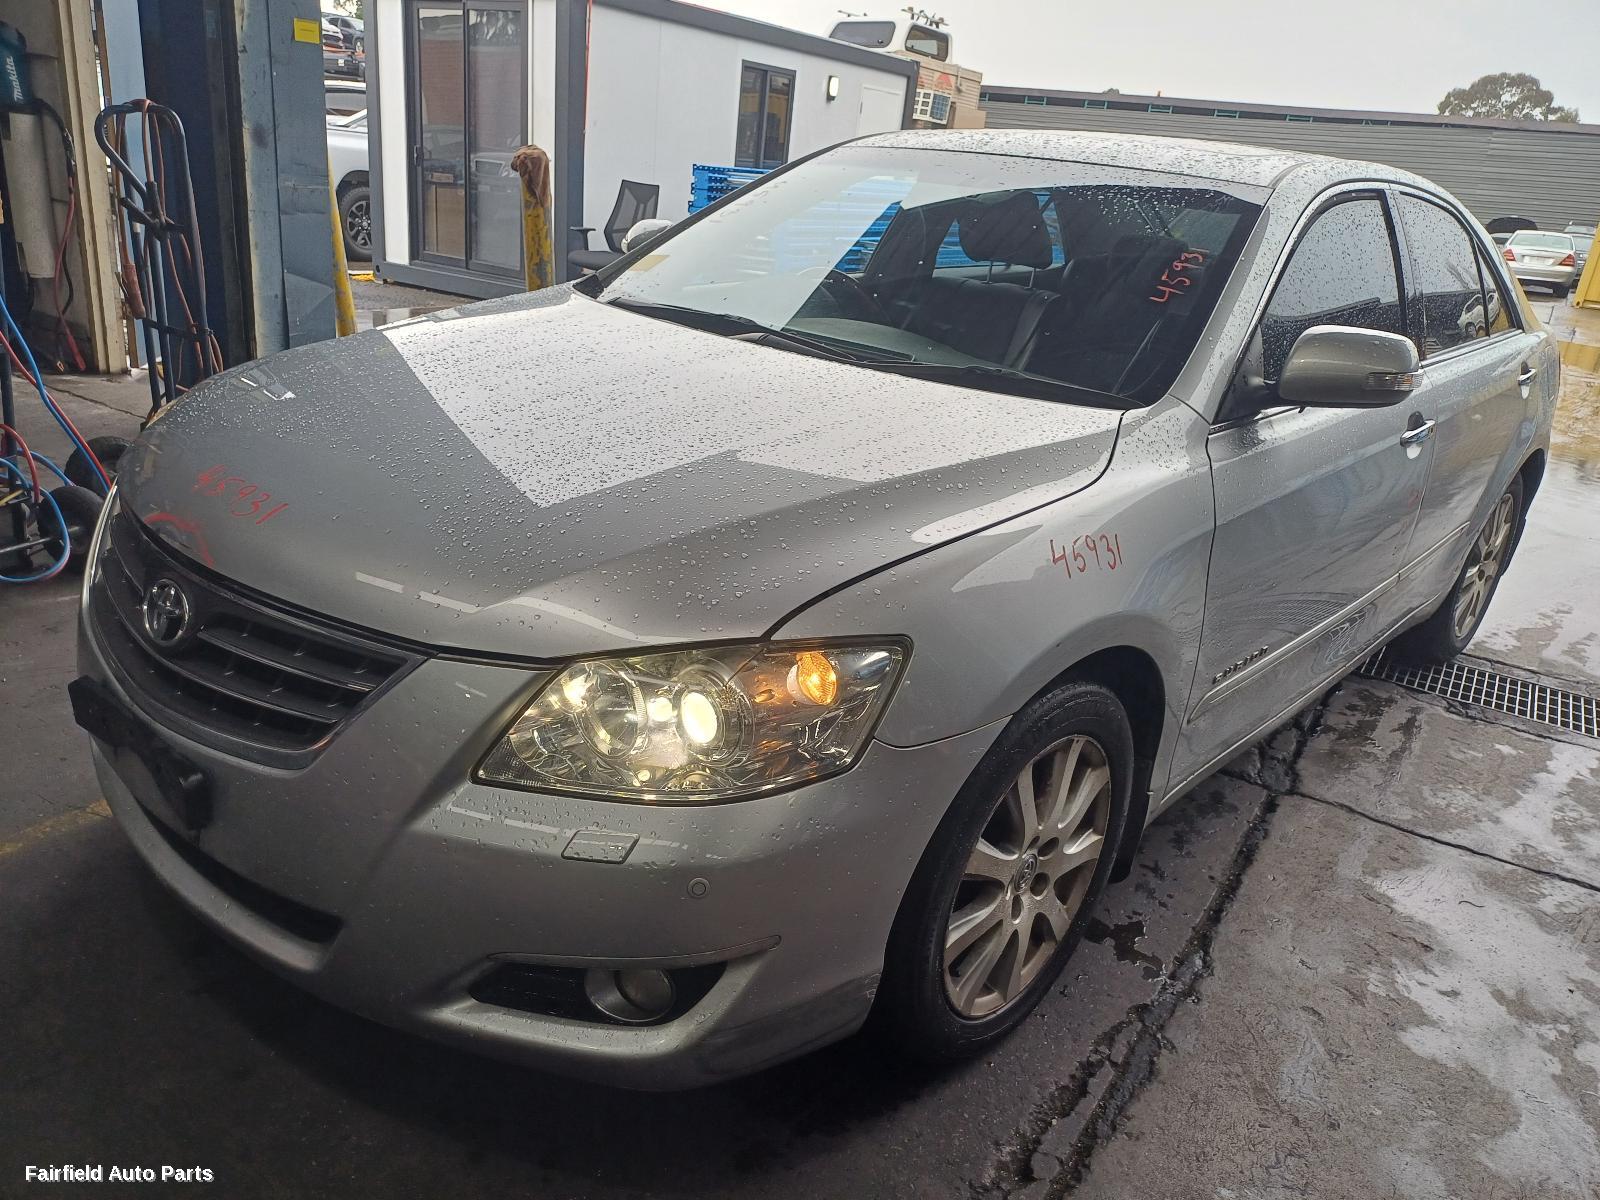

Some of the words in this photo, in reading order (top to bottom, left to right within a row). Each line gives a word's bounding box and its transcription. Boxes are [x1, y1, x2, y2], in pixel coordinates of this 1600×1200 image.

[1149, 247, 1210, 302] 45931
[192, 464, 289, 525] 45931
[1049, 533, 1123, 579] 45931
